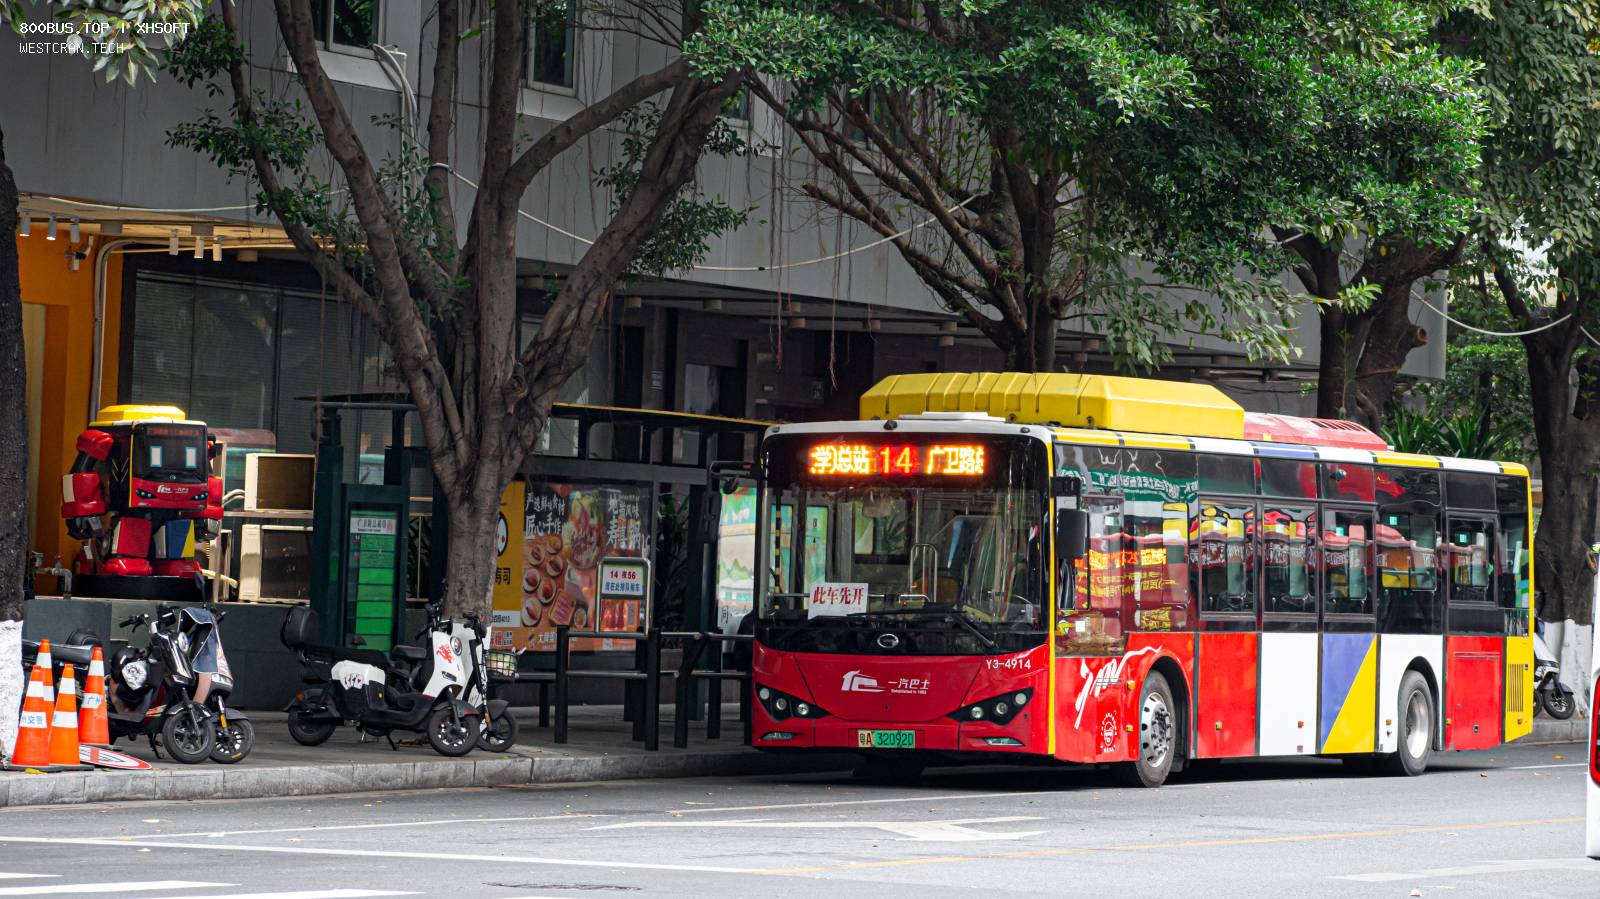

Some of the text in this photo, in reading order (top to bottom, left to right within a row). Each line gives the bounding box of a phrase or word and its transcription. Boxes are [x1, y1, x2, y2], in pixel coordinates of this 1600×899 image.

[880, 446, 913, 474] 14
[813, 585, 865, 606] 此车先开
[986, 658, 1032, 670] Y3-4914
[888, 678, 930, 690] 一汽巴士
